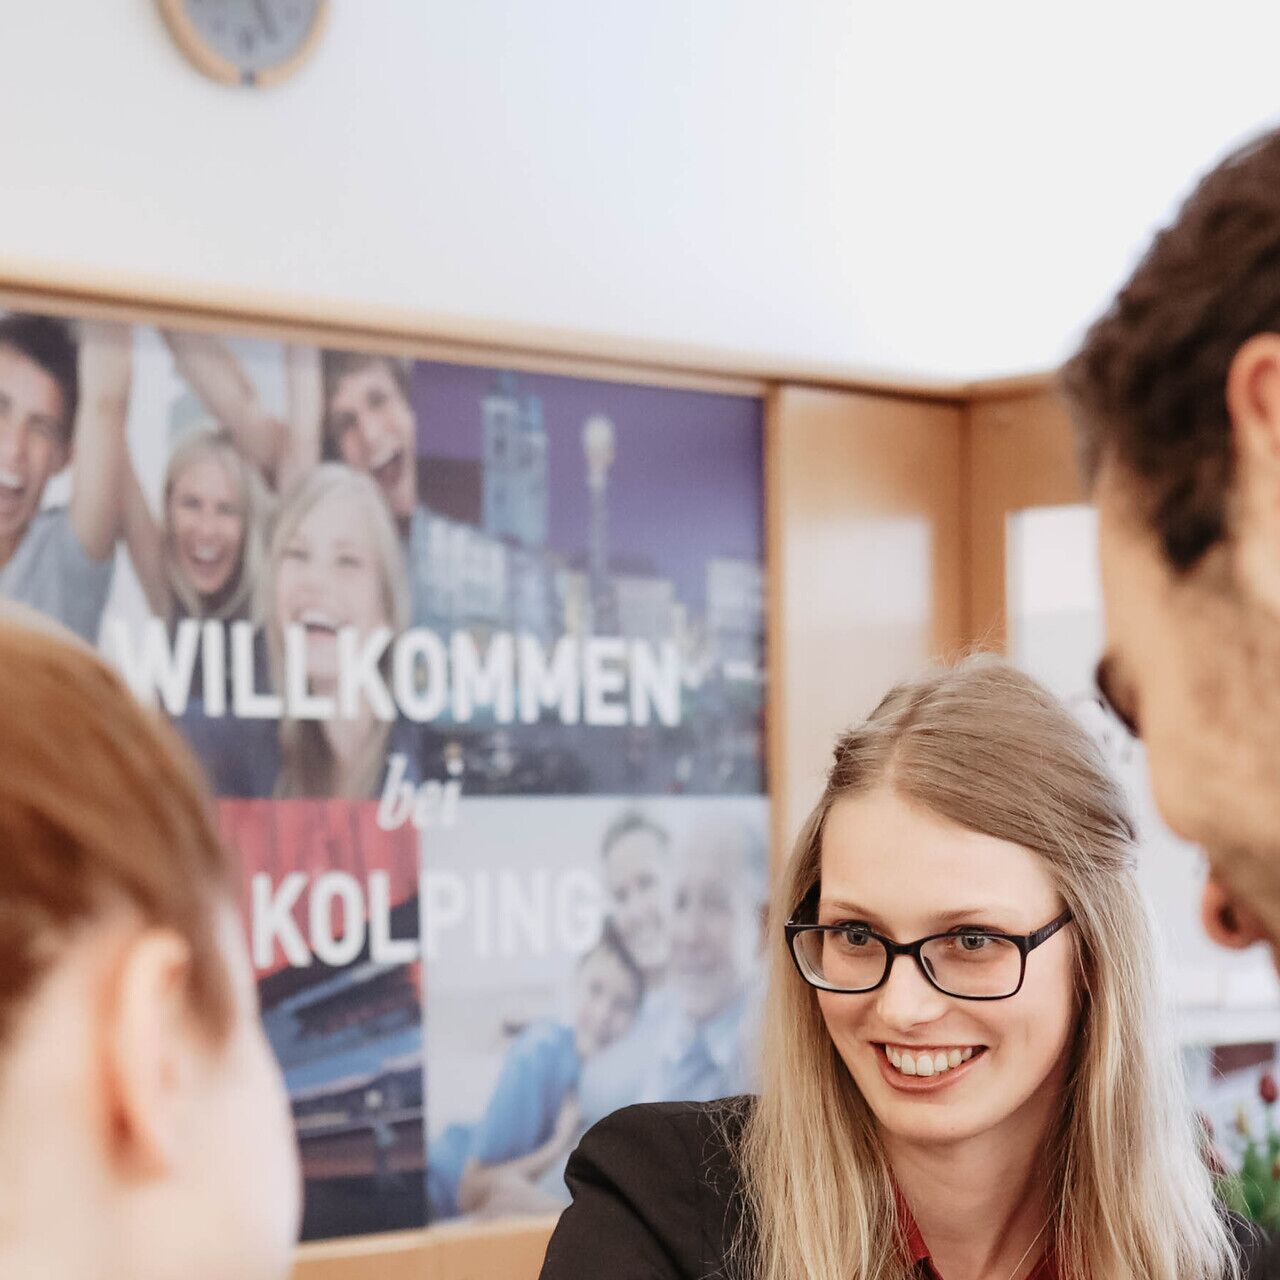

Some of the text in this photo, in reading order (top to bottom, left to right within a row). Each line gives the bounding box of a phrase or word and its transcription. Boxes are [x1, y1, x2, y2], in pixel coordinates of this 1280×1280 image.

[108, 616, 682, 727] WILLKOMMEN
[376, 752, 464, 832] bei
[250, 867, 604, 970] KOLPING
